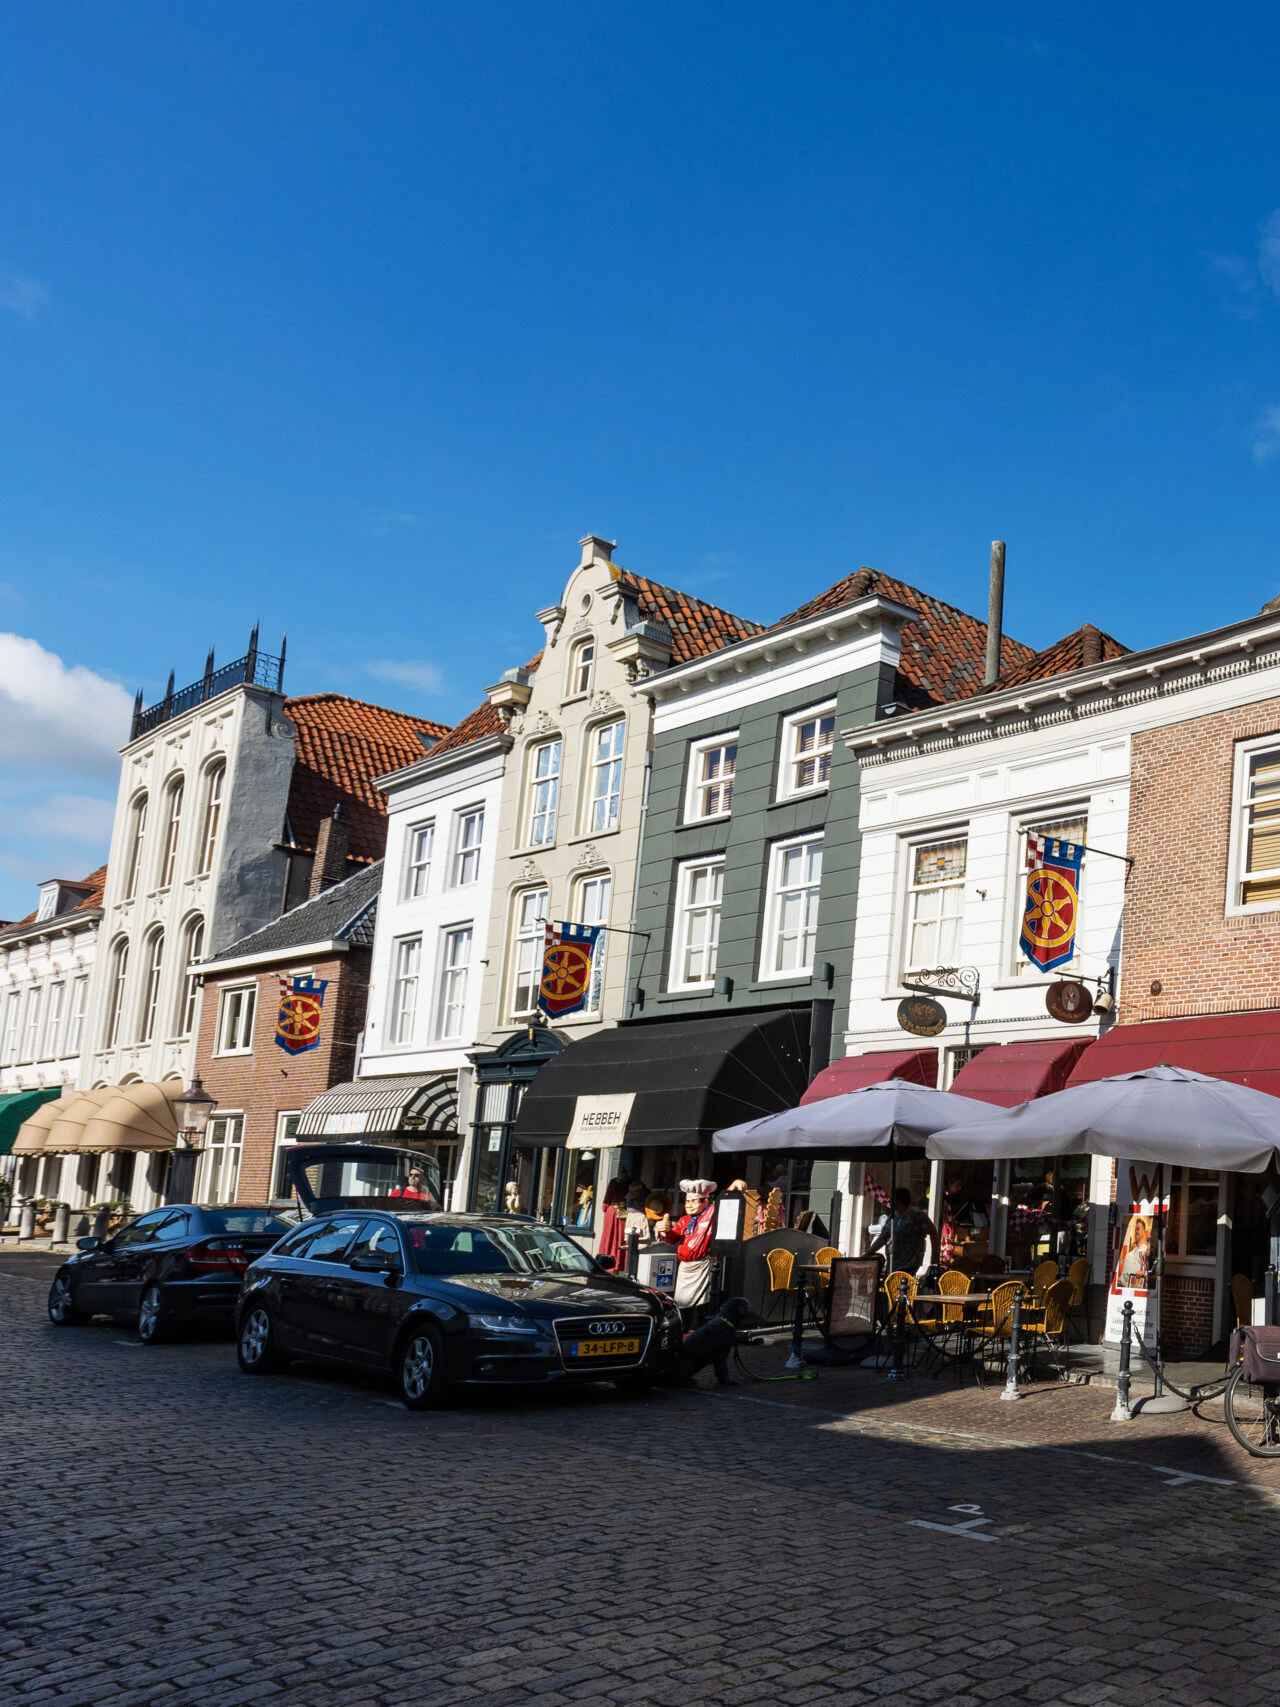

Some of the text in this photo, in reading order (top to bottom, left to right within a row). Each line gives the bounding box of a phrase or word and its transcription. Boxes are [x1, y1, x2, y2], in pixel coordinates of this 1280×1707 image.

[581, 1111, 622, 1127] HEBBEH
[583, 1341, 635, 1354] 34-LFP-8
[947, 1503, 985, 1515] P
